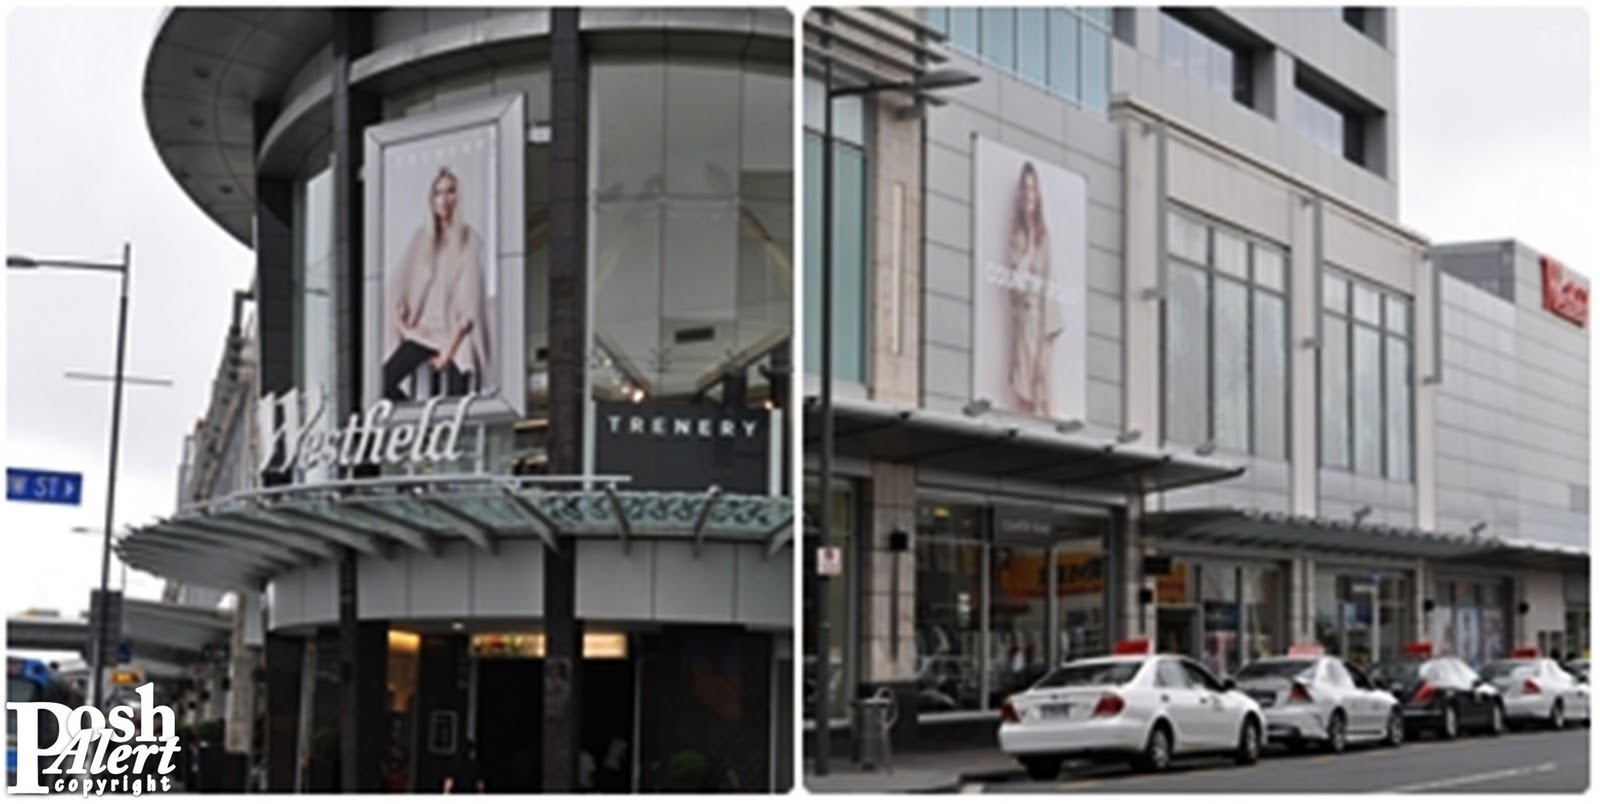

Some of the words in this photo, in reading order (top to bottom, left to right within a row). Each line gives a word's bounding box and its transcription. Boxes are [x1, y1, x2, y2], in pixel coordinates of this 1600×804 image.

[257, 386, 477, 475] Westfield
[608, 415, 759, 438] TRENERY
[34, 476, 59, 498] ST
